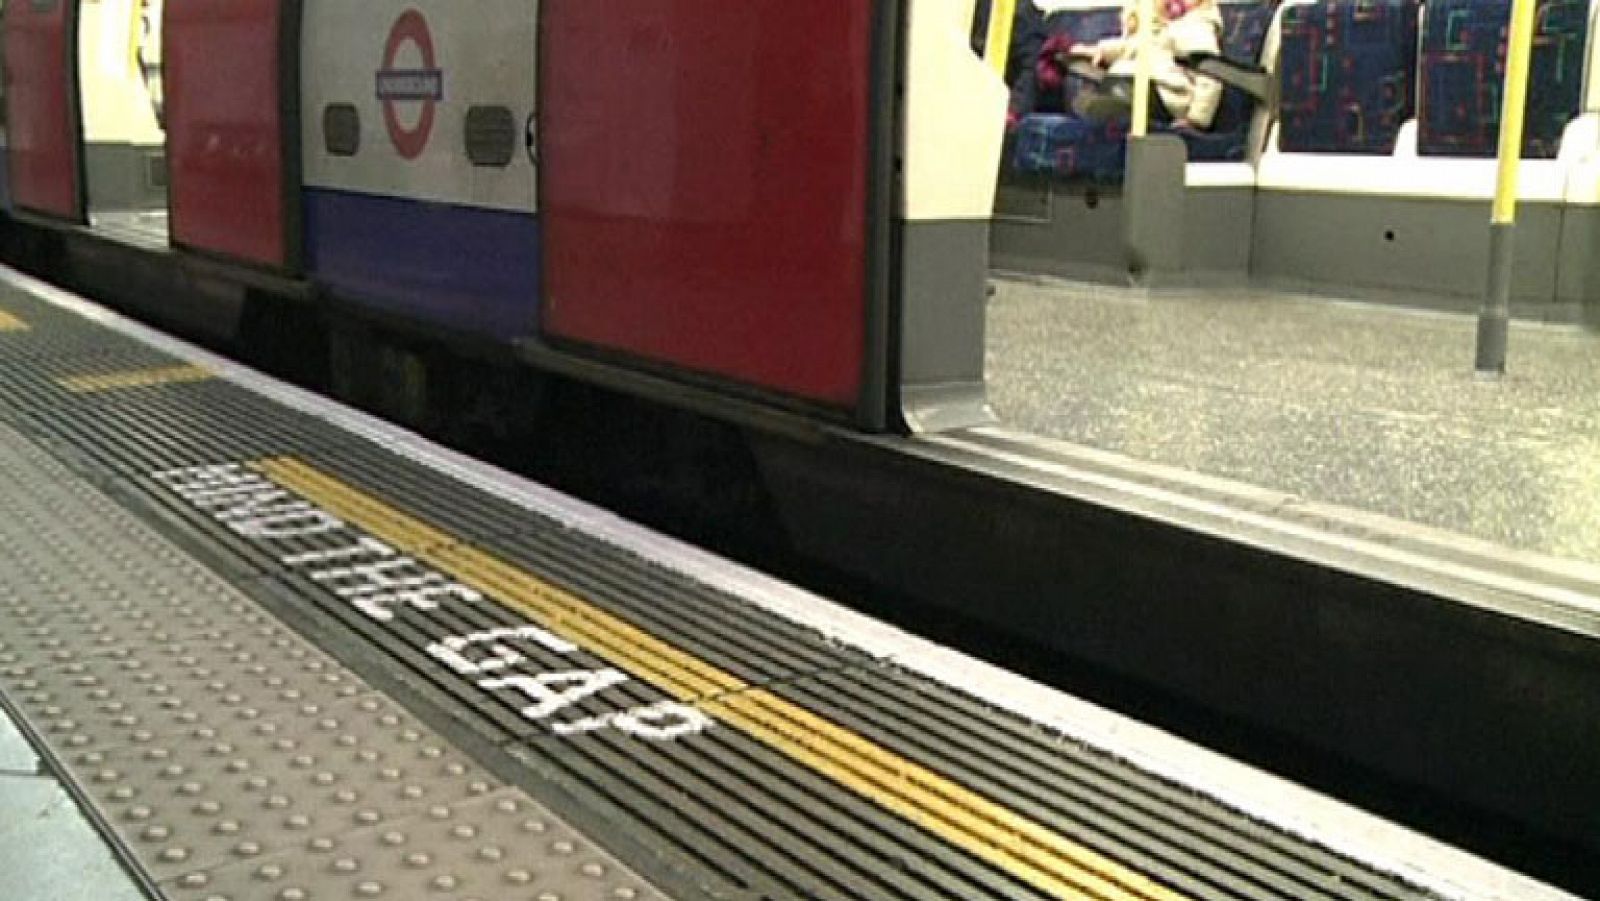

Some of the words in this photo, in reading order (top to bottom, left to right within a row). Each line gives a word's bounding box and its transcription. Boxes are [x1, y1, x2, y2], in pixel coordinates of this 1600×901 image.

[152, 462, 344, 537] MIND
[281, 536, 482, 621] THE
[426, 626, 716, 740] GAP
